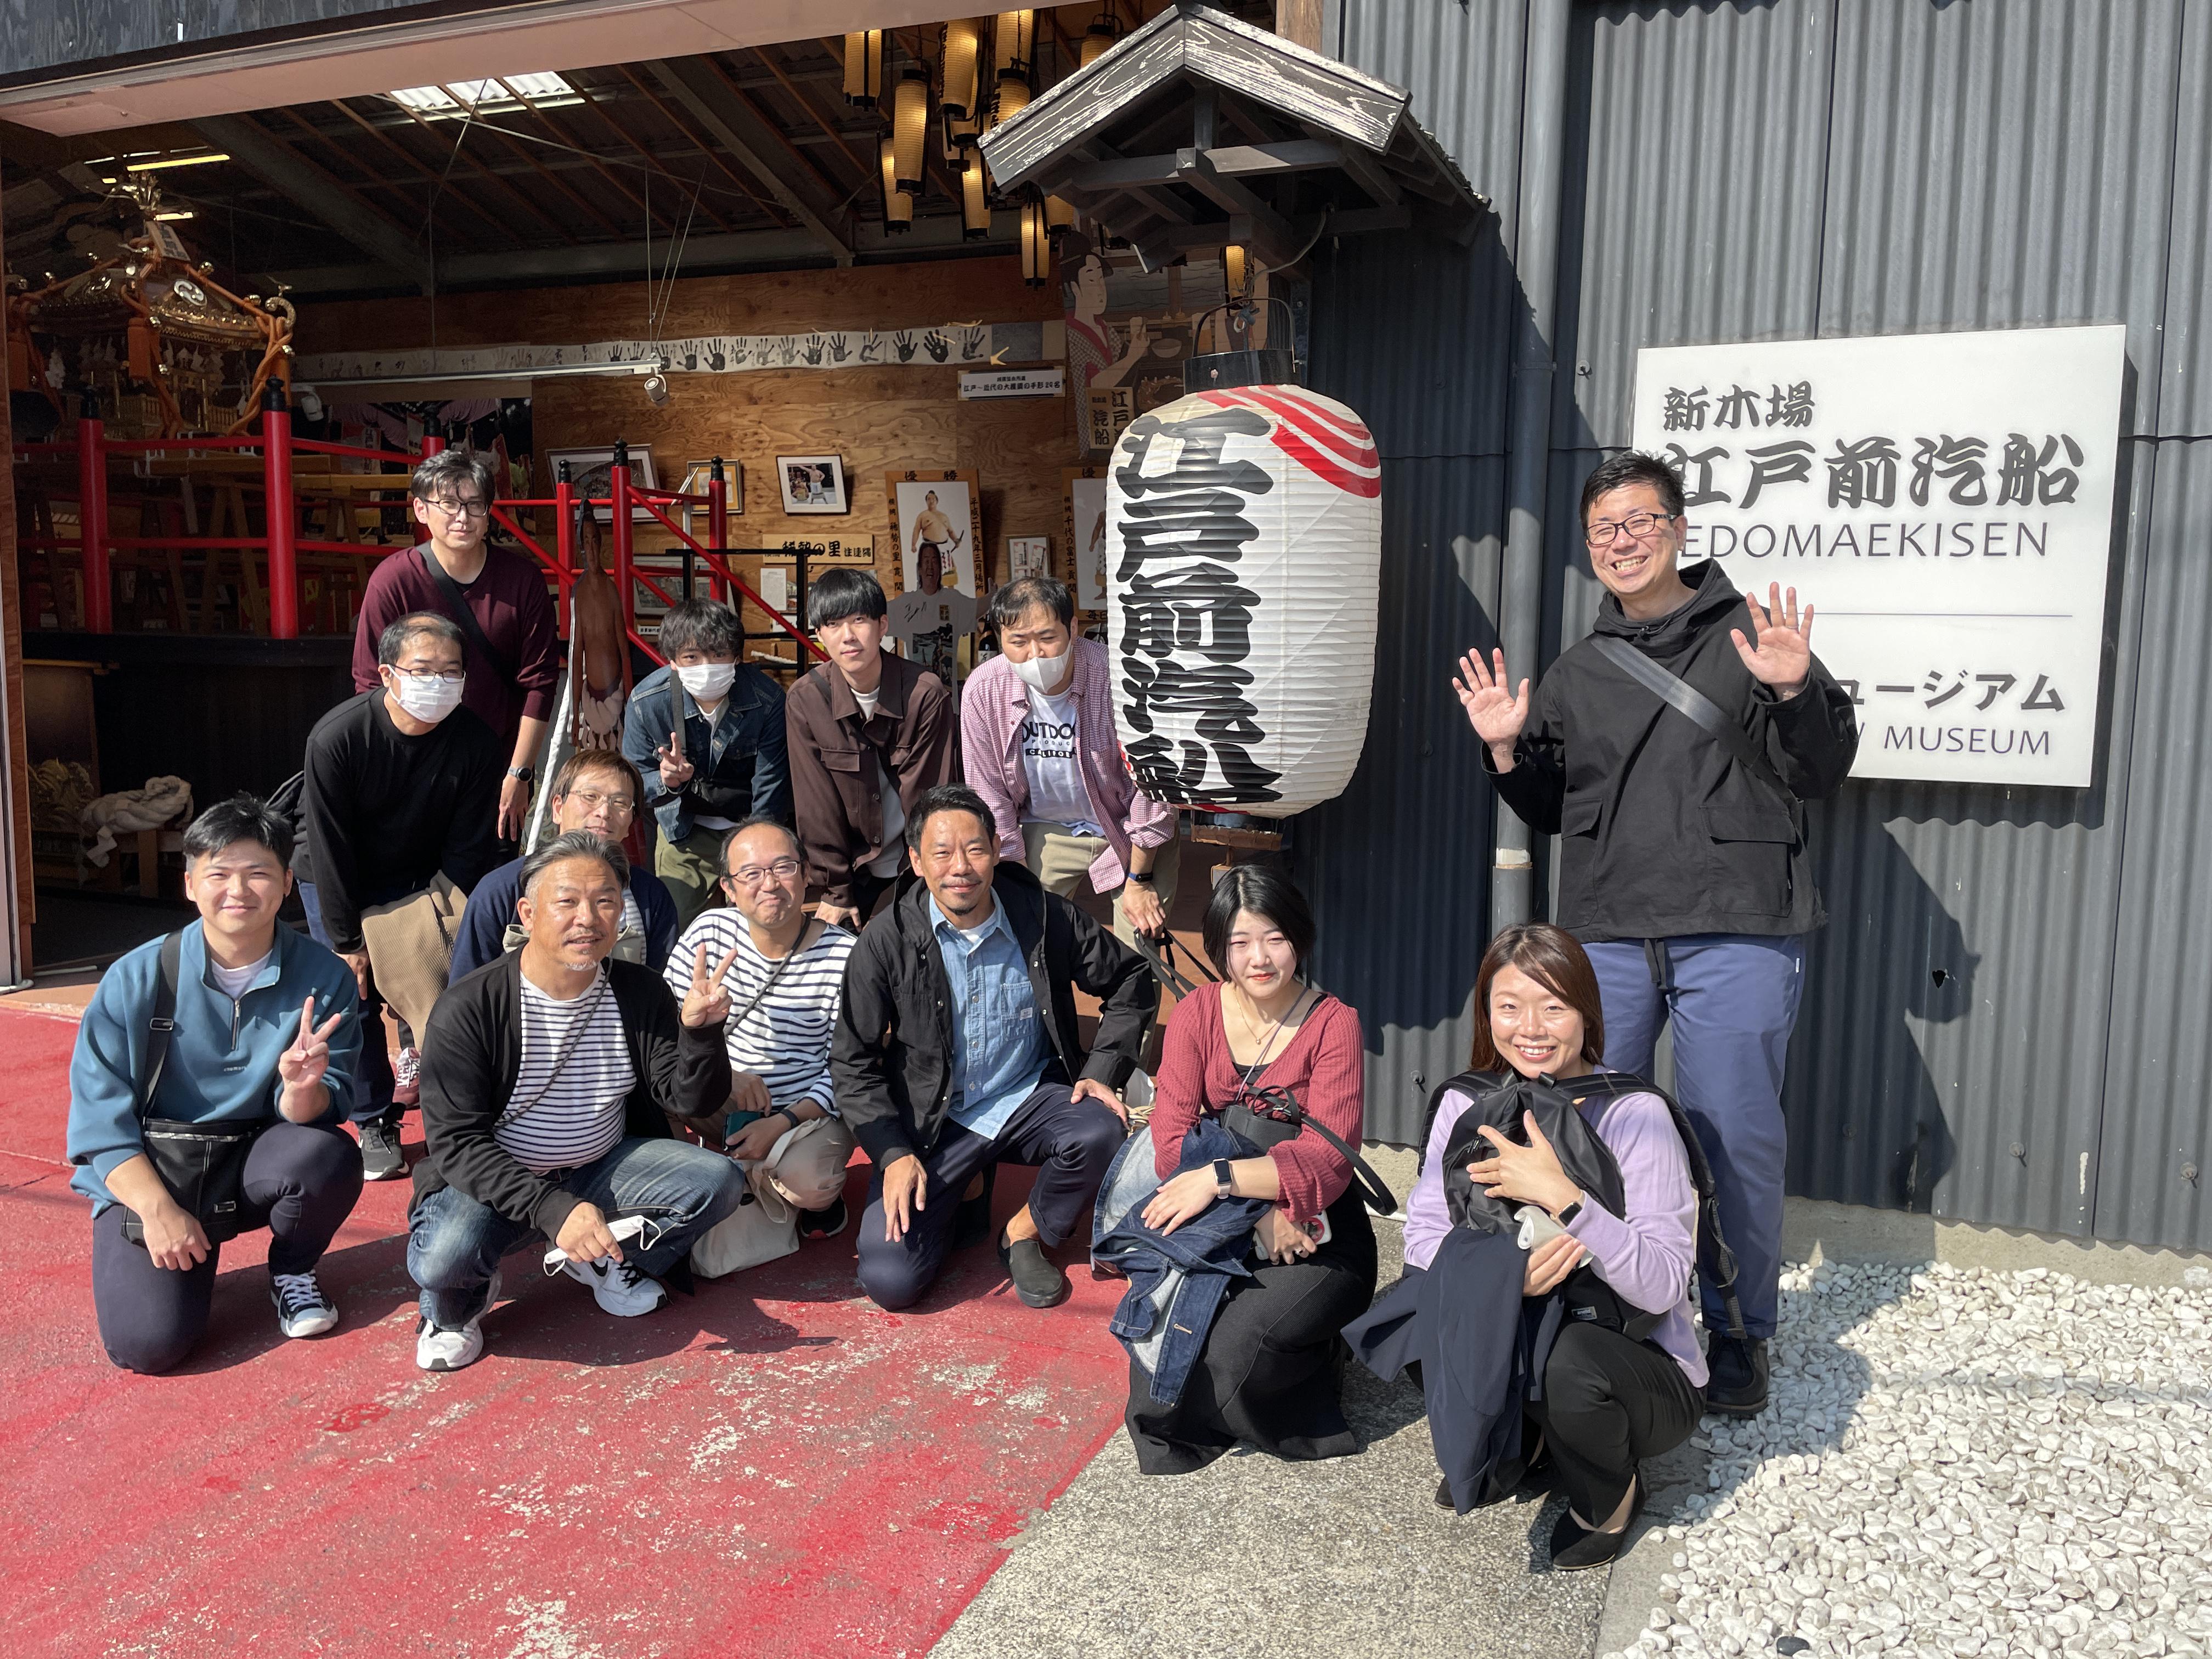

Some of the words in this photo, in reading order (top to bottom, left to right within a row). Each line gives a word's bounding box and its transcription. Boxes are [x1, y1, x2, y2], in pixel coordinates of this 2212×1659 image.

[1663, 381, 1815, 431] 新木場
[1093, 410, 1109, 445] 汽船
[1666, 433, 2084, 509] 江戸前汽船
[1681, 522, 2047, 558] EDOMAEKISEN
[1116, 409, 1283, 804] 江戸前汽船
[1022, 721, 1076, 742] OUTDO
[1884, 725, 2049, 755] MUSEUM
